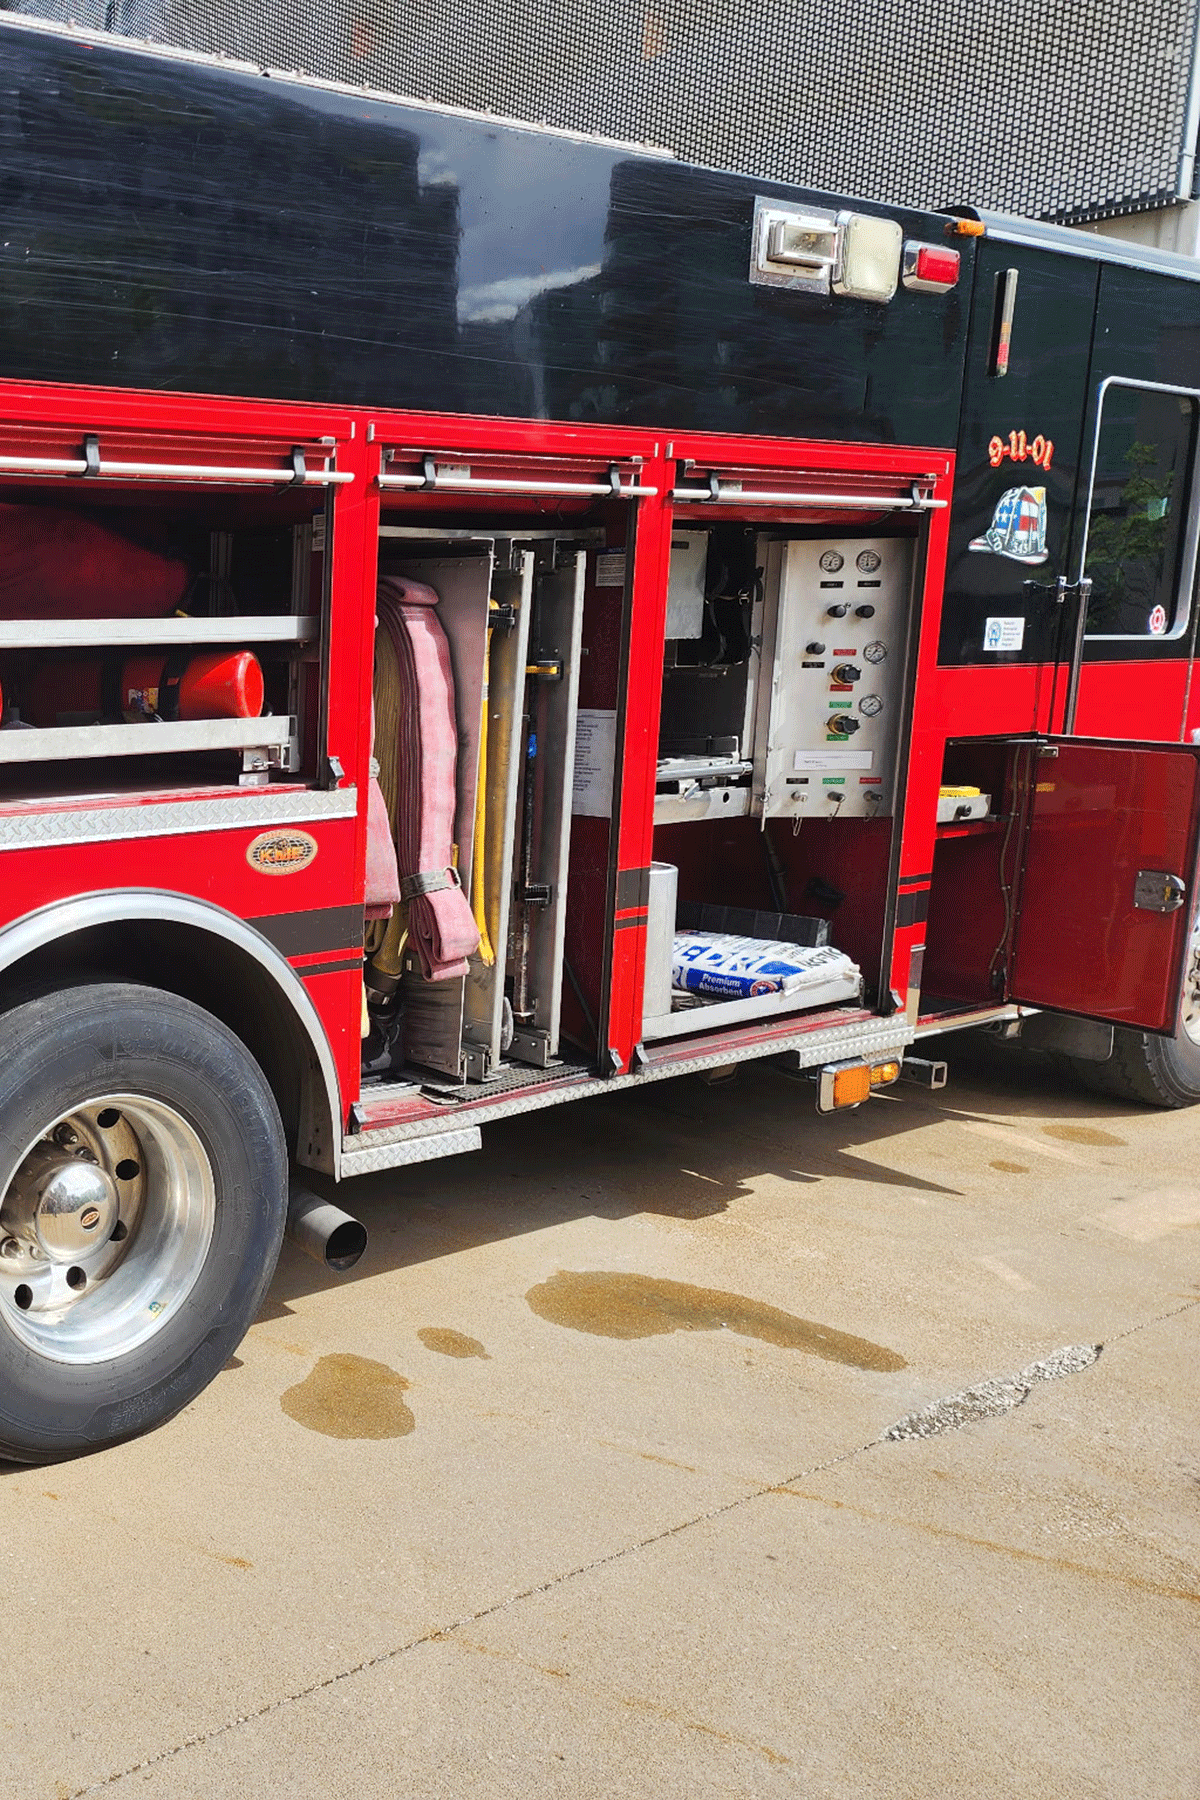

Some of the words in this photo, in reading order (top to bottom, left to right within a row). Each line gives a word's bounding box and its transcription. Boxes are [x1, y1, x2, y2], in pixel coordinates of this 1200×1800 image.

[988, 429, 1055, 472] 9-11-01
[701, 972, 742, 988] Premium
[698, 982, 745, 998] Absorbent
